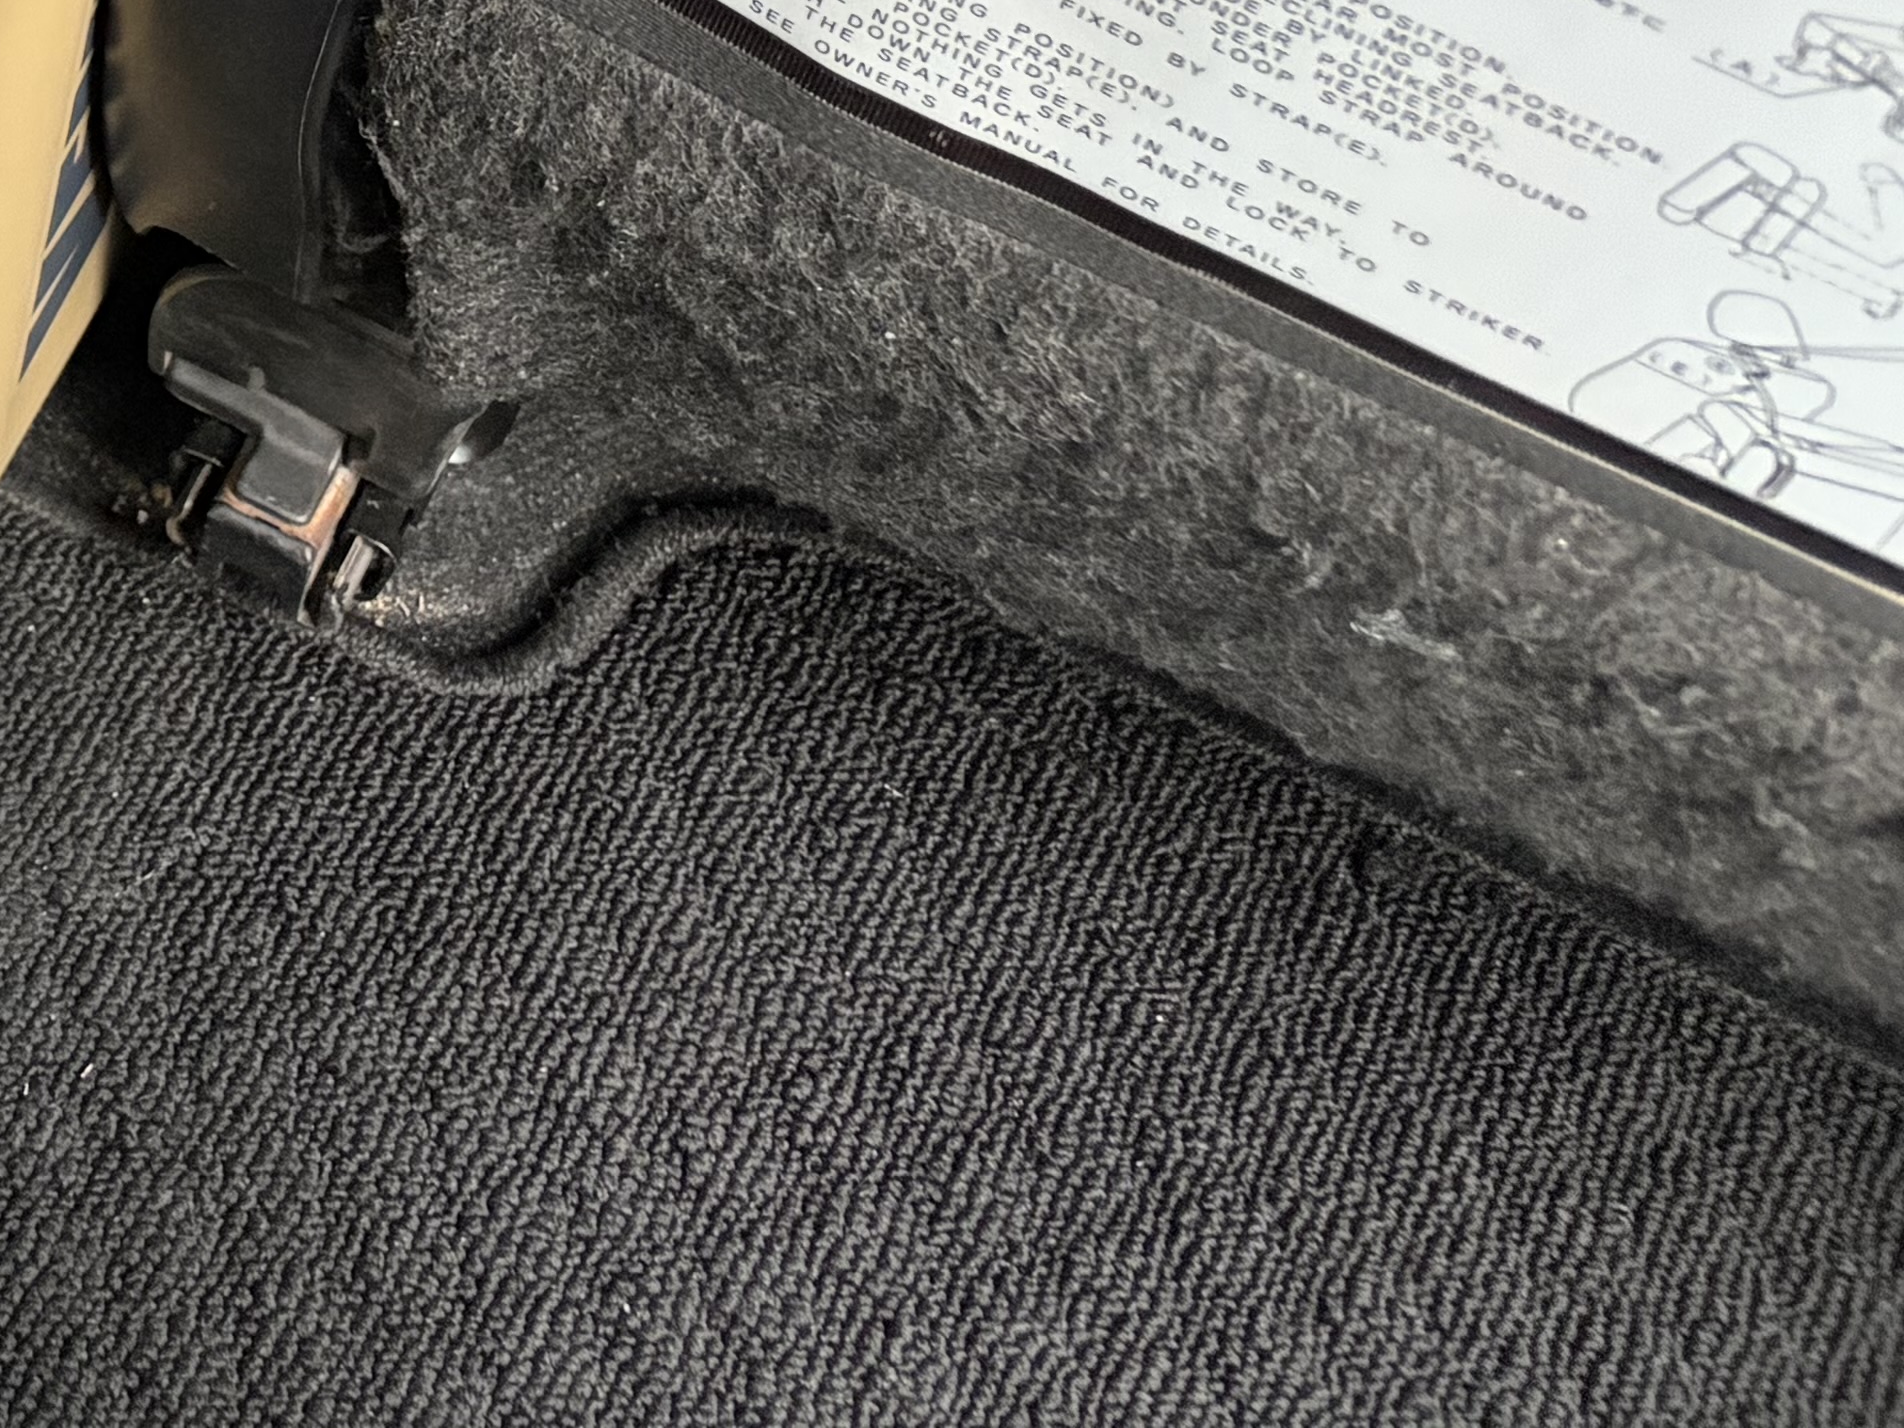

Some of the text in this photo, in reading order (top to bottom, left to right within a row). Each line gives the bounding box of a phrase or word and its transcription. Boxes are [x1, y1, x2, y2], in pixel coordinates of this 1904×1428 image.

[805, 4, 855, 44] THE
[1013, 22, 1174, 109] POSITION)
[1166, 51, 1206, 77] BY
[1210, 19, 1290, 63] SEAT
[1283, 18, 1327, 44] BY
[748, 0, 795, 35] SEE
[814, 39, 938, 109] OWNER'S
[959, 111, 1076, 173] MANUAL
[1101, 176, 1160, 213] FOR
[871, 7, 1004, 79] NOTHING
[1029, 83, 1107, 128] GETS
[1132, 133, 1164, 156] IN
[1192, 160, 1249, 197] THE
[1211, 37, 1295, 81] LOOP
[1318, 89, 1426, 142] STRAP
[846, 13, 931, 64] DOWN
[958, 66, 1013, 101] THE
[1036, 104, 1113, 147] SEAT
[1136, 154, 1200, 189] AND
[1225, 195, 1309, 242] LOCK
[1339, 246, 1377, 273] TO
[1165, 117, 1230, 153] AND
[1256, 158, 1362, 216] STORE
